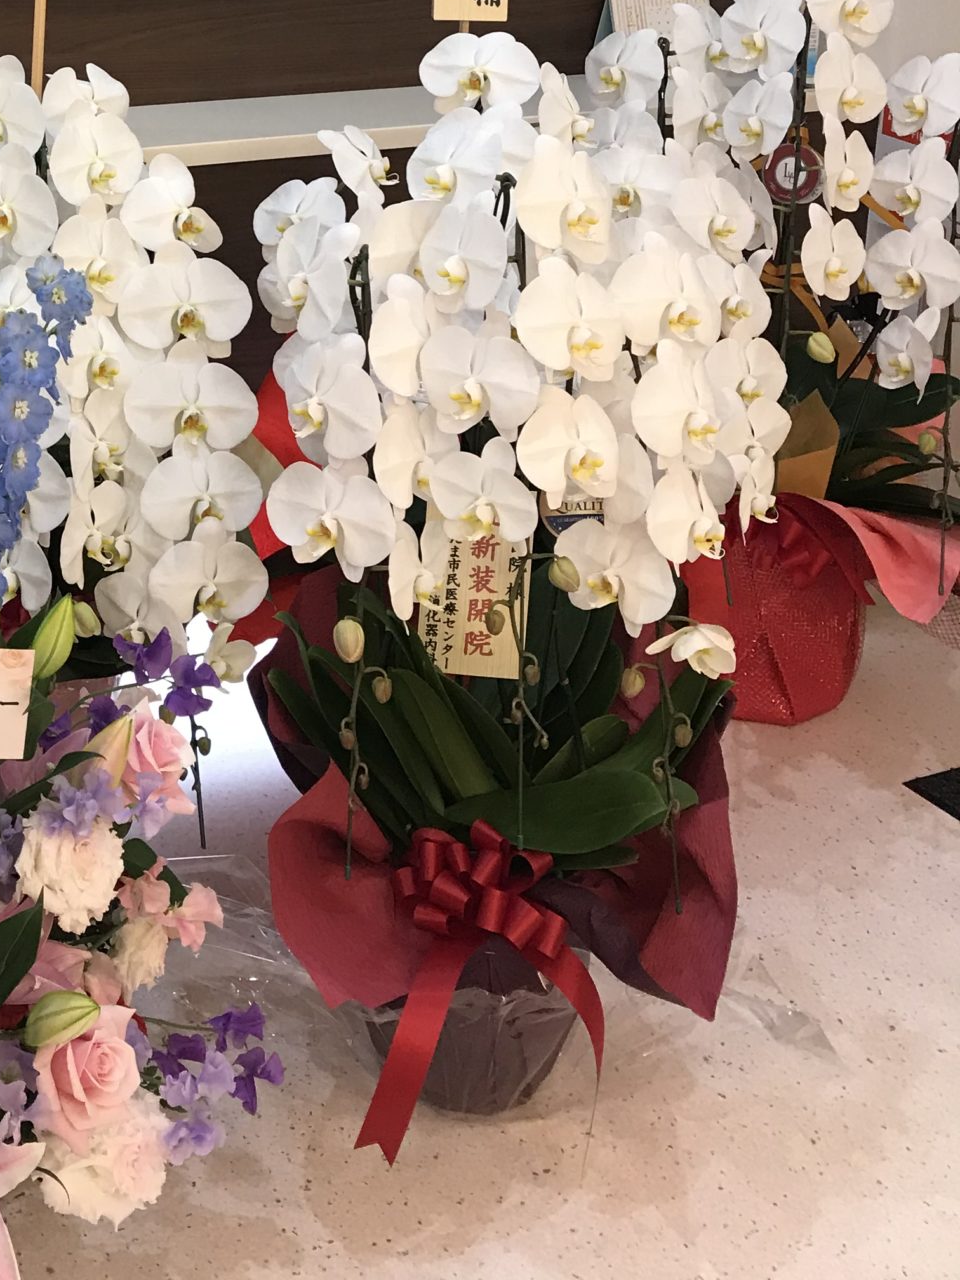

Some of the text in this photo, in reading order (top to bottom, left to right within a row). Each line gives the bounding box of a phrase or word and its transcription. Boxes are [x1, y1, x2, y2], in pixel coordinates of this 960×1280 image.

[551, 500, 604, 514] UALIT
[463, 512, 501, 658] 新装開院
